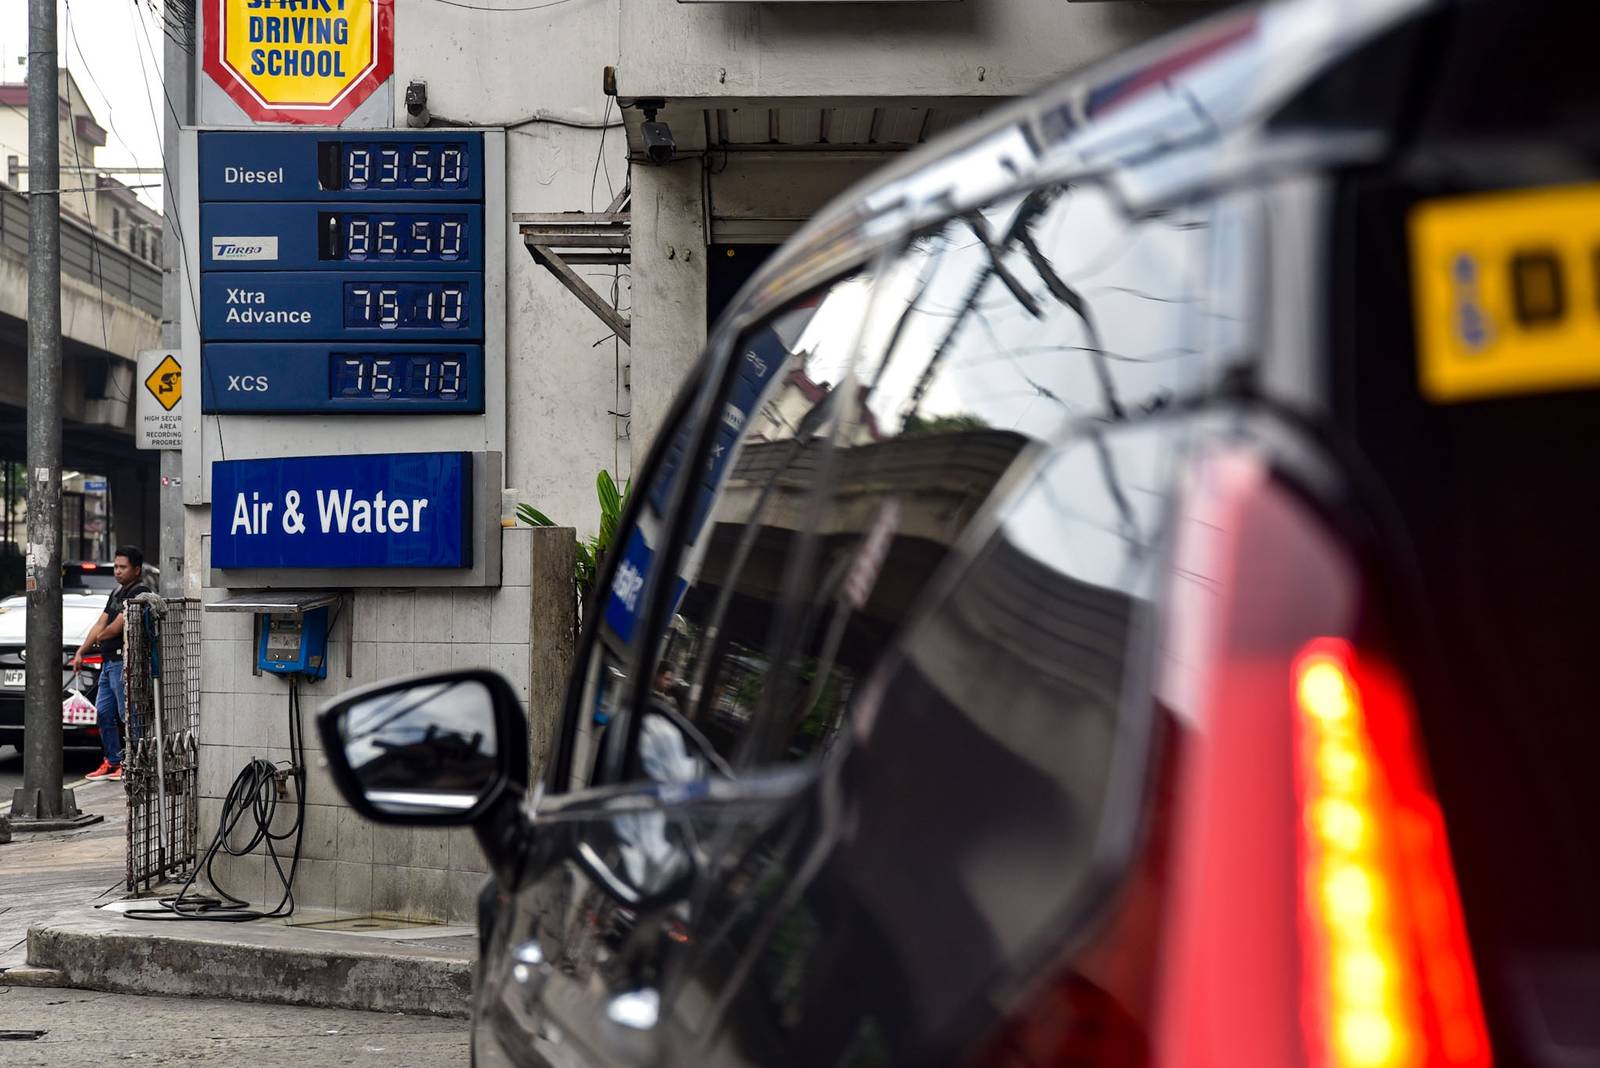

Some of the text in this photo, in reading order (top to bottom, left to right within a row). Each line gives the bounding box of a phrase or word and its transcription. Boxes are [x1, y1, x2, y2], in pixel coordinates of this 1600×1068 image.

[249, 16, 348, 45] DRIVING
[251, 49, 345, 77] SCHOOL
[225, 167, 283, 183] Diesel
[348, 222, 461, 253] 86.50
[226, 289, 265, 304] Xtra
[226, 308, 311, 323] Advance
[227, 376, 269, 392] XCS
[230, 489, 428, 535] Air & Water
